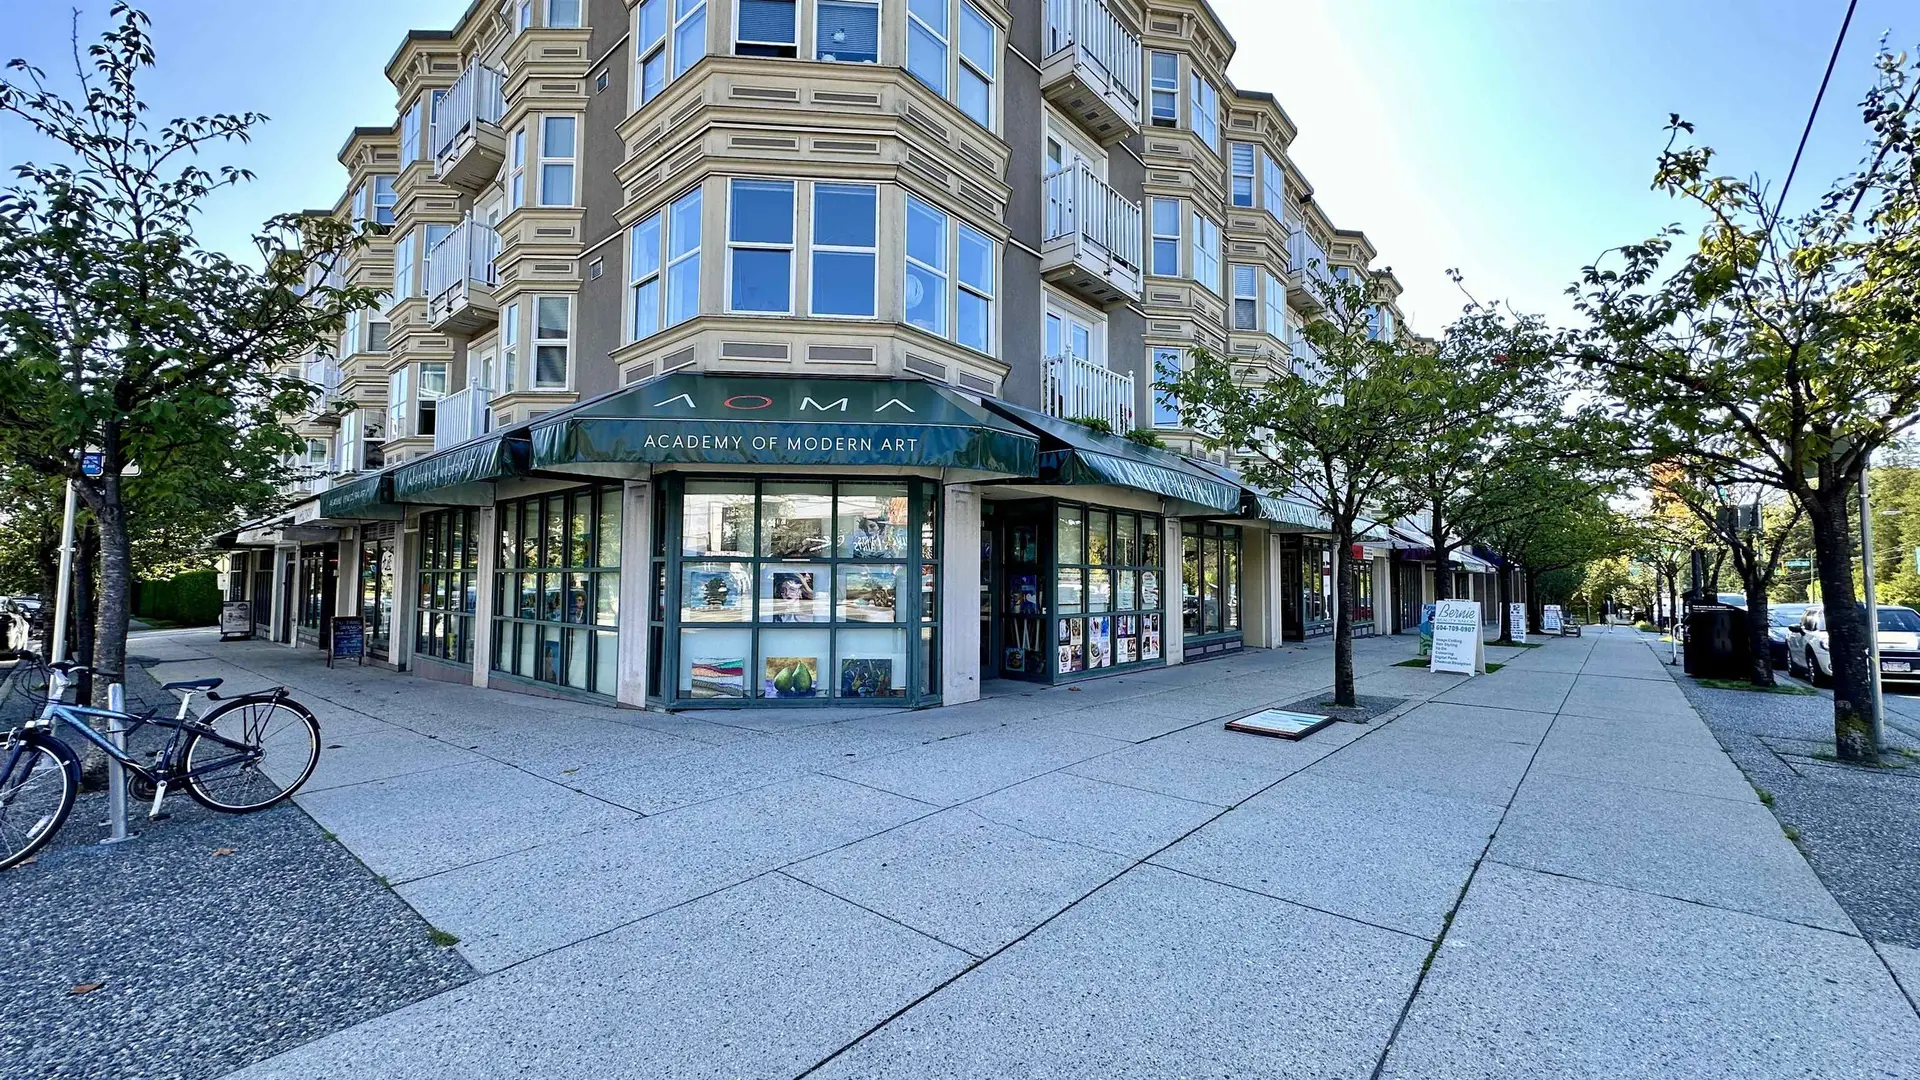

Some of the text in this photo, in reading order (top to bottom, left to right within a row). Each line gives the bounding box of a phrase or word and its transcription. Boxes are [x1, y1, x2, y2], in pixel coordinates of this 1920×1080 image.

[644, 434, 918, 452] ACADEMY OF MODERN ART
[1438, 603, 1475, 619] Bernie
